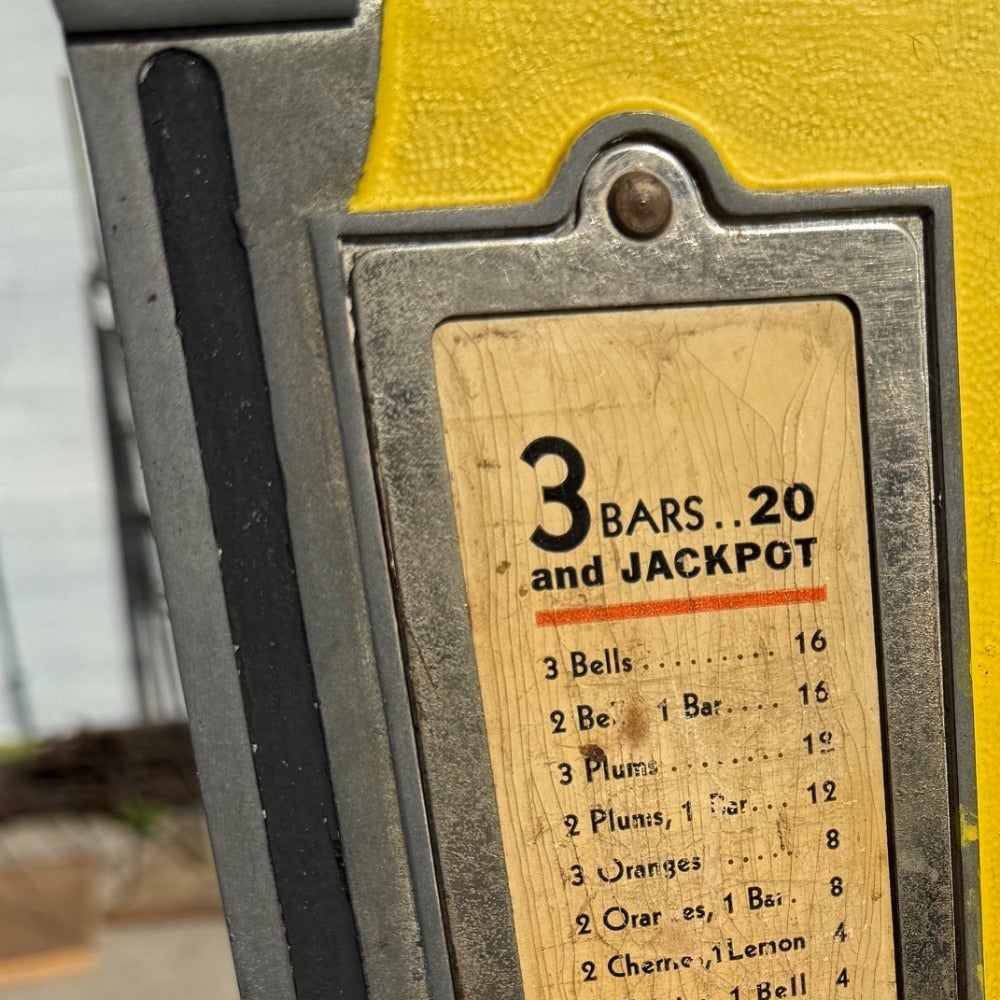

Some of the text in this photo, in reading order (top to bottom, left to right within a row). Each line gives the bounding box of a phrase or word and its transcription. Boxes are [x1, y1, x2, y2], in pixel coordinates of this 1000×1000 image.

[520, 435, 591, 553] 3
[748, 482, 815, 526] 20
[531, 537, 817, 592] and JACKPOT
[544, 629, 827, 680] 3 Bells 16
[550, 710, 566, 734] 2
[683, 693, 722, 719] Bar
[798, 681, 829, 705] 16
[557, 763, 573, 785] 3
[585, 756, 658, 782] Plums
[564, 814, 580, 837] 2
[591, 809, 672, 834] Plums,
[682, 800, 693, 822] 1
[807, 781, 837, 804] 12
[570, 829, 840, 886] 3 Oranges 8
[576, 913, 591, 934] 2
[724, 893, 734, 913] 1
[830, 877, 844, 897] 8
[582, 961, 597, 982] 2
[833, 922, 847, 942] 4
[836, 968, 850, 988] 4
